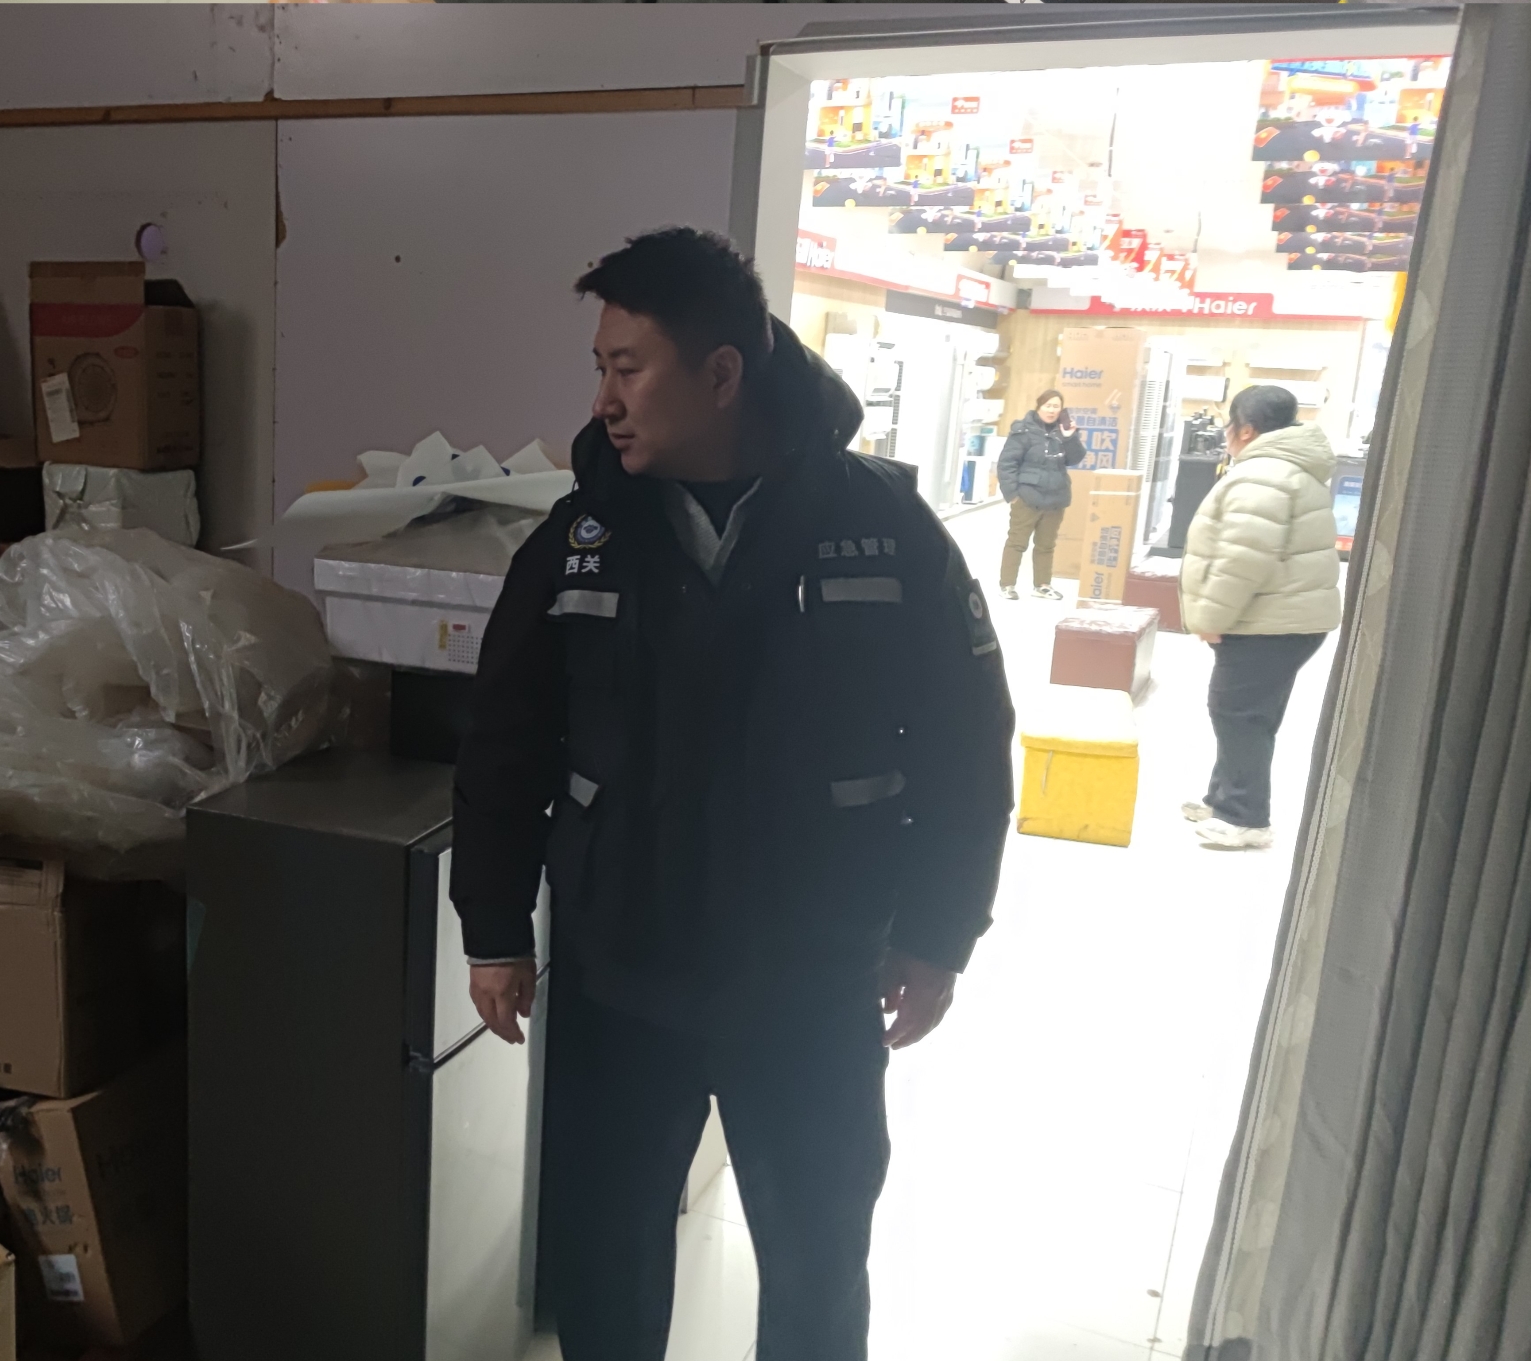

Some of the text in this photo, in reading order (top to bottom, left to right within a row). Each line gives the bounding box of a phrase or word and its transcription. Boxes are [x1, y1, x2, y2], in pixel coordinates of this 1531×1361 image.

[1193, 296, 1258, 316] Haier
[1061, 367, 1104, 382] Haier
[565, 554, 600, 576] 西关
